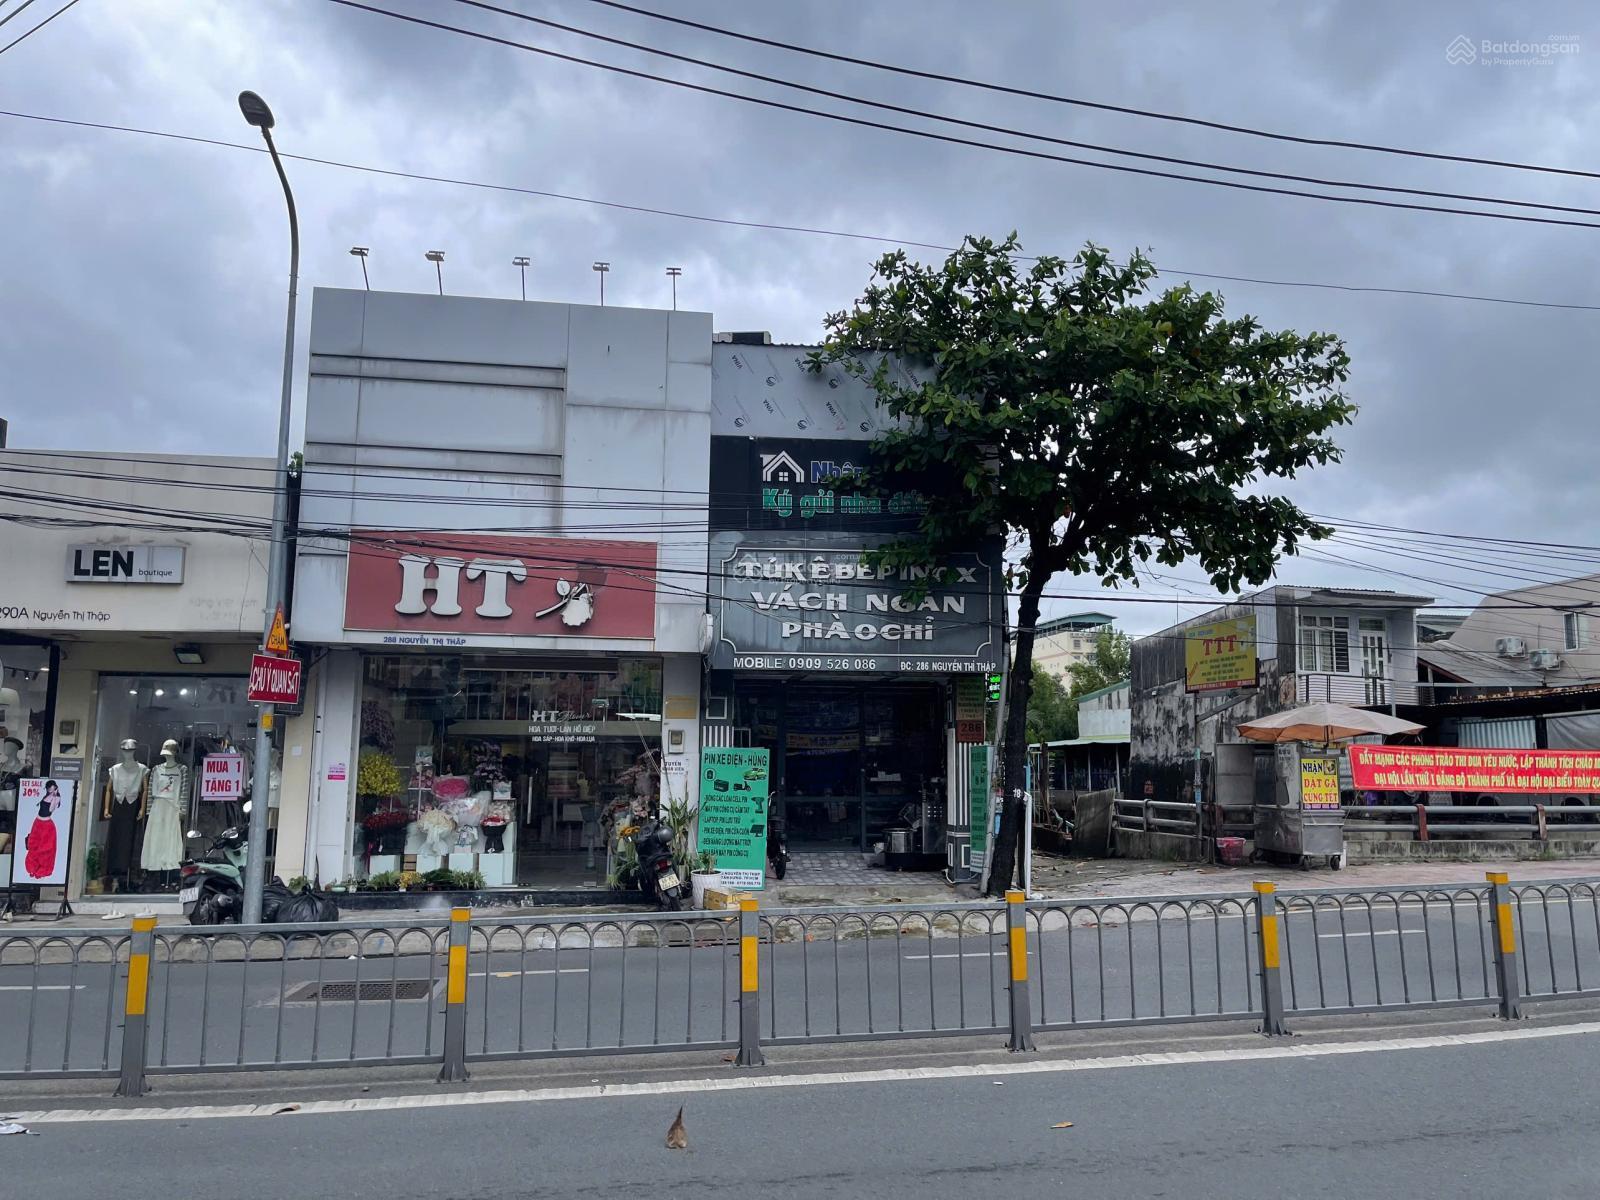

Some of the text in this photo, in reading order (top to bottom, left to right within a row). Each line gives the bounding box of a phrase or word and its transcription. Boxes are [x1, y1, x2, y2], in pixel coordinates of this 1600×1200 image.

[762, 488, 793, 517] Ký
[801, 488, 835, 518] gửi
[73, 549, 173, 577] LEN boutique
[395, 554, 528, 618] HT
[751, 582, 847, 611] VÁCH
[33, 609, 70, 622] Nguyễn
[73, 610, 85, 622] Thị
[87, 611, 111, 621] Thập
[1203, 634, 1237, 656] TTT
[788, 658, 822, 670] 0909
[826, 659, 850, 670] 526
[854, 659, 876, 670] 086
[916, 662, 929, 671] 286
[252, 662, 267, 691] CHÚ
[271, 669, 288, 694] QUAN
[287, 665, 299, 694] SÁT
[961, 723, 982, 733] 286
[206, 760, 241, 773] MUA 1
[704, 753, 716, 764] PIN
[717, 754, 726, 764] XE
[1302, 760, 1322, 774] NHẬN
[1375, 753, 1394, 767] MẠNH
[1396, 752, 1409, 766] CÁC
[1411, 754, 1434, 766] PHONG
[1435, 753, 1454, 766] TRÀO
[1455, 755, 1466, 767] THI
[1468, 756, 1482, 767] ĐUA
[1483, 754, 1497, 768] YÊU
[1535, 754, 1557, 768] THÀNH
[1559, 755, 1574, 769] TÍCH
[1575, 755, 1593, 769] CHÀO
[205, 777, 240, 794] TẶNG 1
[1374, 772, 1386, 787] ĐẠI
[1388, 771, 1400, 787] HỘI
[1415, 770, 1431, 785] THỨ
[1467, 772, 1490, 787] THÀNH
[1491, 771, 1505, 787] PHỐ
[1506, 773, 1516, 787] VÀ
[1517, 775, 1529, 789] ĐẠI
[1530, 773, 1542, 790] HỘI
[1544, 775, 1555, 789] ĐẠI
[1573, 773, 1591, 788] TOÀN
[23, 788, 40, 797] 30%
